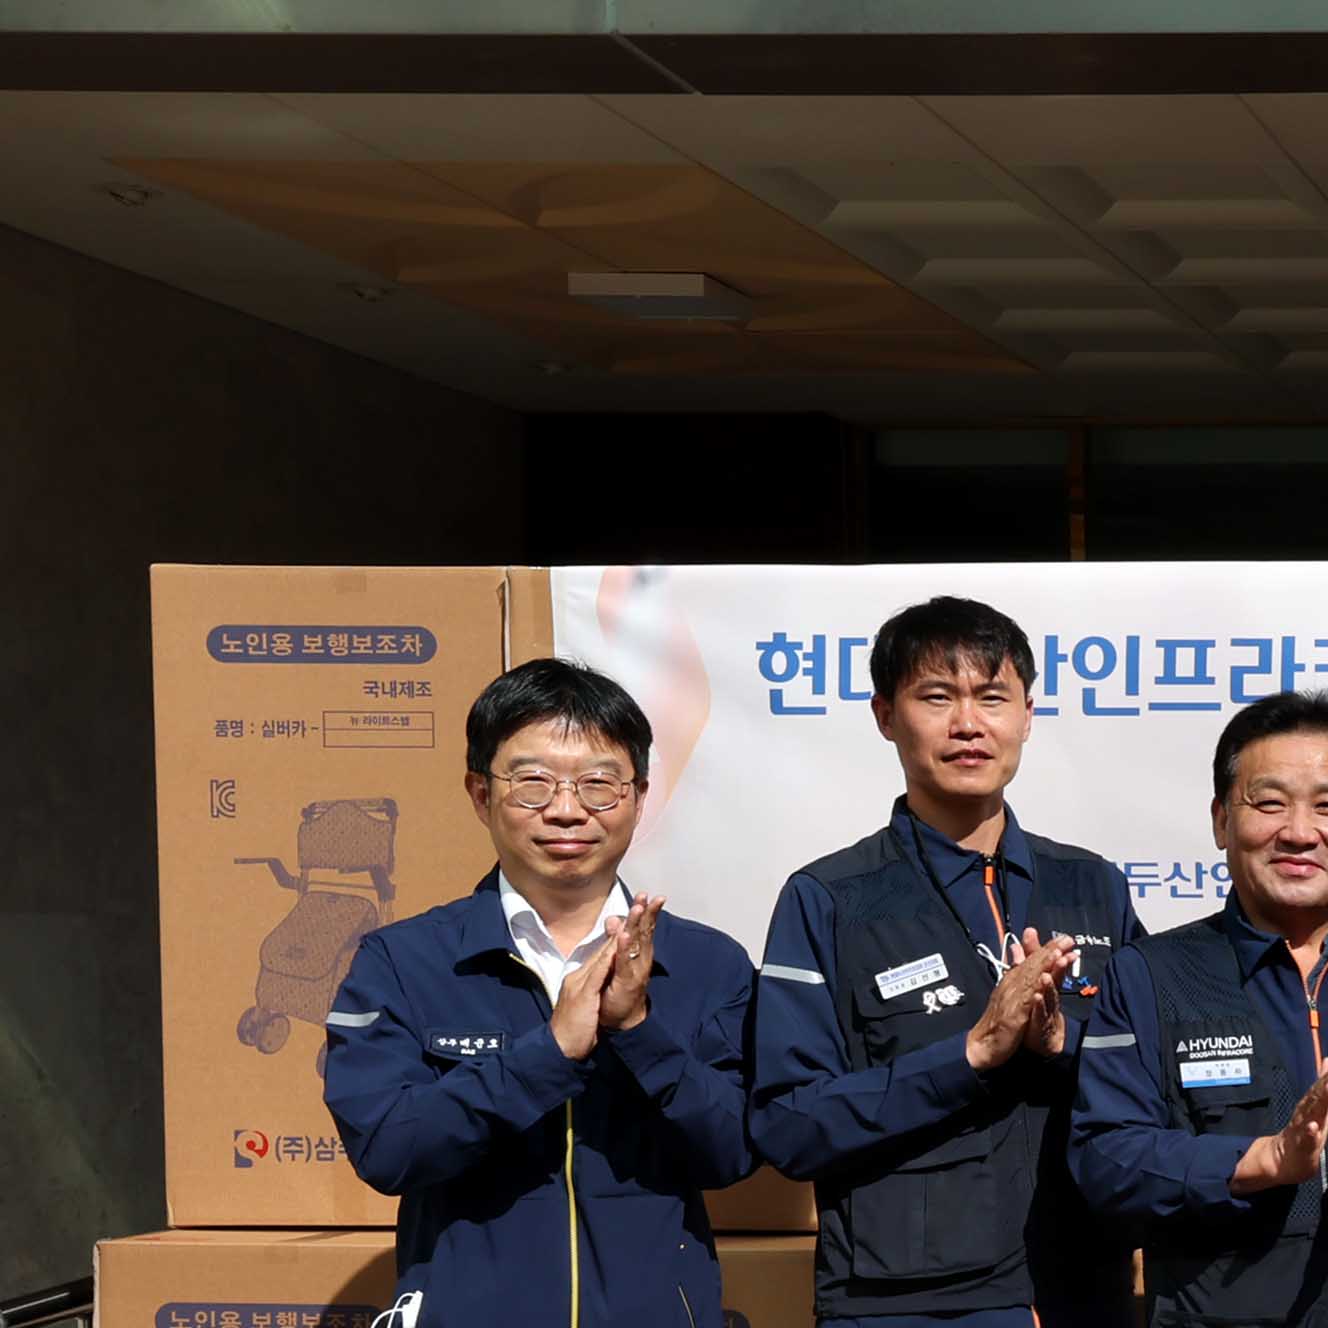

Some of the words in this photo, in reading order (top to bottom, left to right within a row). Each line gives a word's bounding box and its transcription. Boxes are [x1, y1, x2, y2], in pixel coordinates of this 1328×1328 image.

[220, 633, 294, 656] 노인용
[301, 633, 423, 657] 보행보조차
[363, 680, 433, 698] 국내제조
[213, 719, 244, 738] 품명
[261, 719, 307, 738] 실버카
[1189, 1034, 1253, 1051] HYUNDAI
